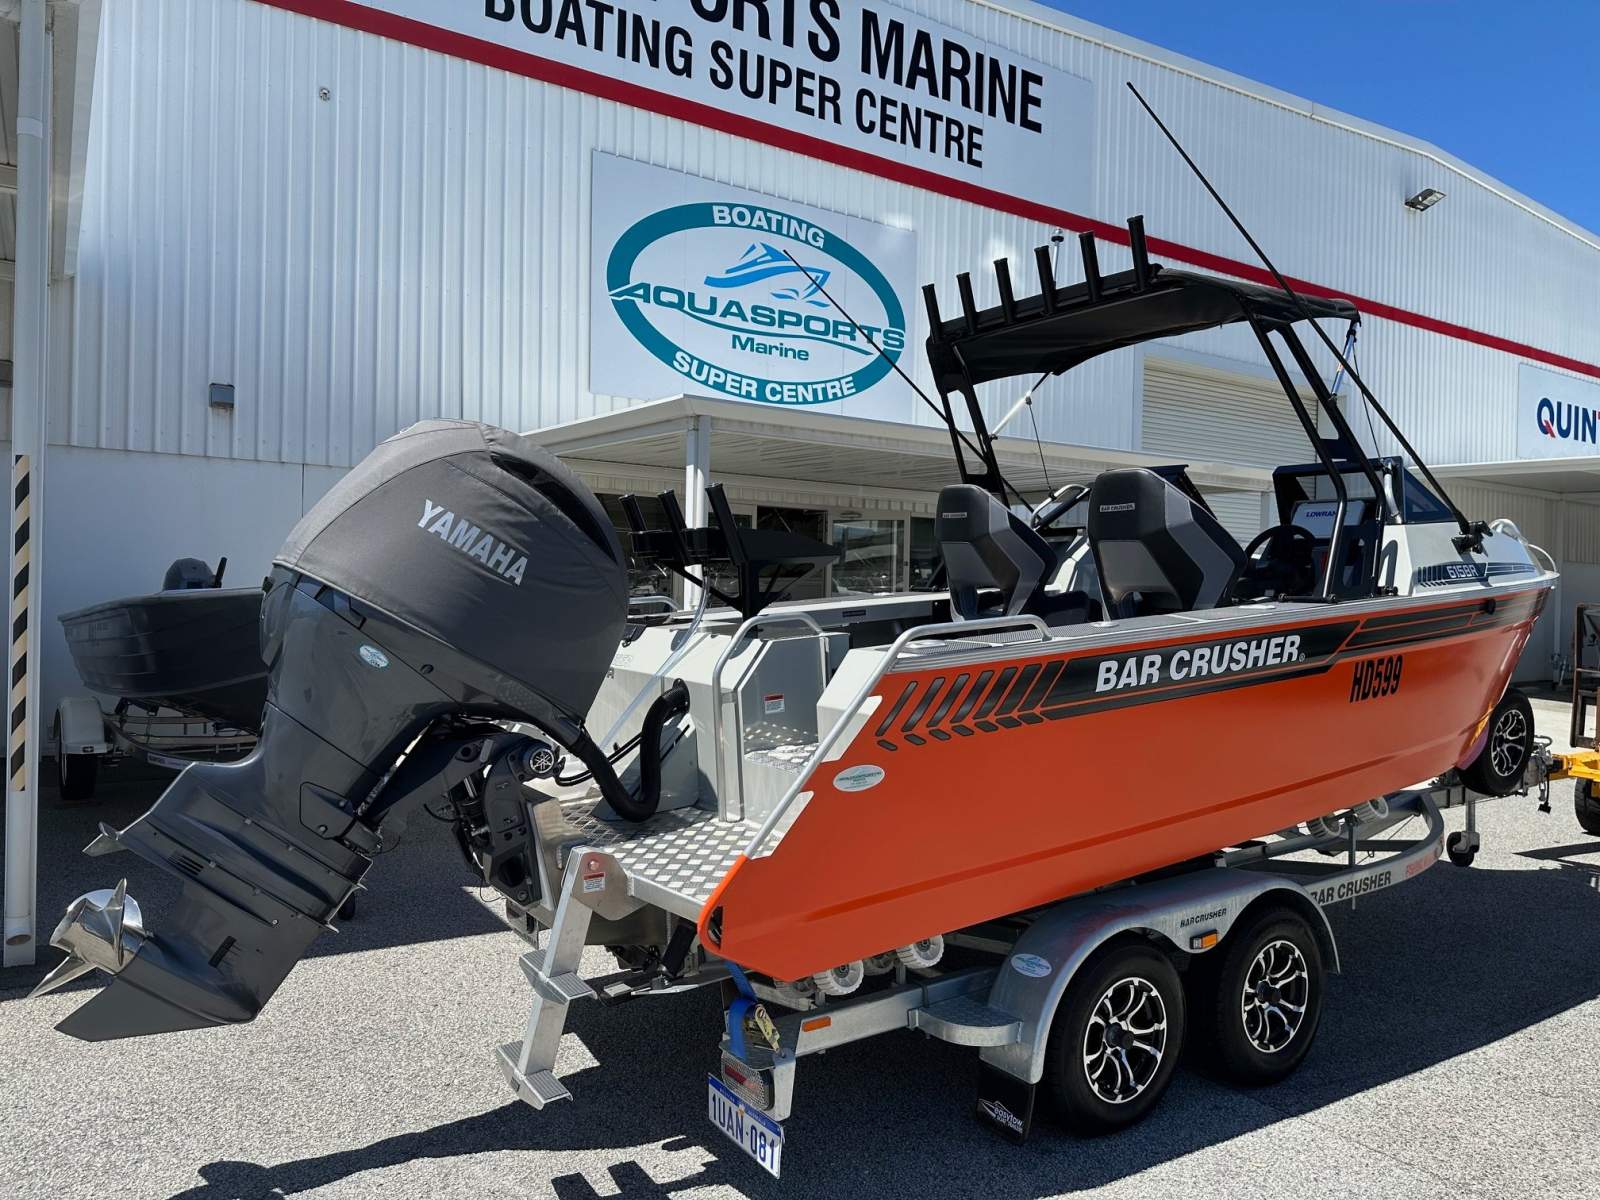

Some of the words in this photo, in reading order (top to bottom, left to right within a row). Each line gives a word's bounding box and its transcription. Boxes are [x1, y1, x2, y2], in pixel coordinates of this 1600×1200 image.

[861, 8, 1043, 134] MARINE
[709, 40, 842, 125] SUPER
[855, 88, 983, 168] CENTRE
[712, 205, 825, 248] BOATING
[609, 282, 905, 350] AQUASPORTS
[731, 334, 809, 361] Marine
[672, 350, 758, 401] SUPER
[765, 376, 857, 402] CENTRE
[1537, 397, 1600, 445] QUIN
[417, 499, 528, 586] YAMAHA
[1095, 654, 1162, 693] BAR
[1169, 634, 1301, 680] CRUSHER
[1349, 654, 1403, 703] HD599
[1337, 870, 1391, 898] CRUSHER
